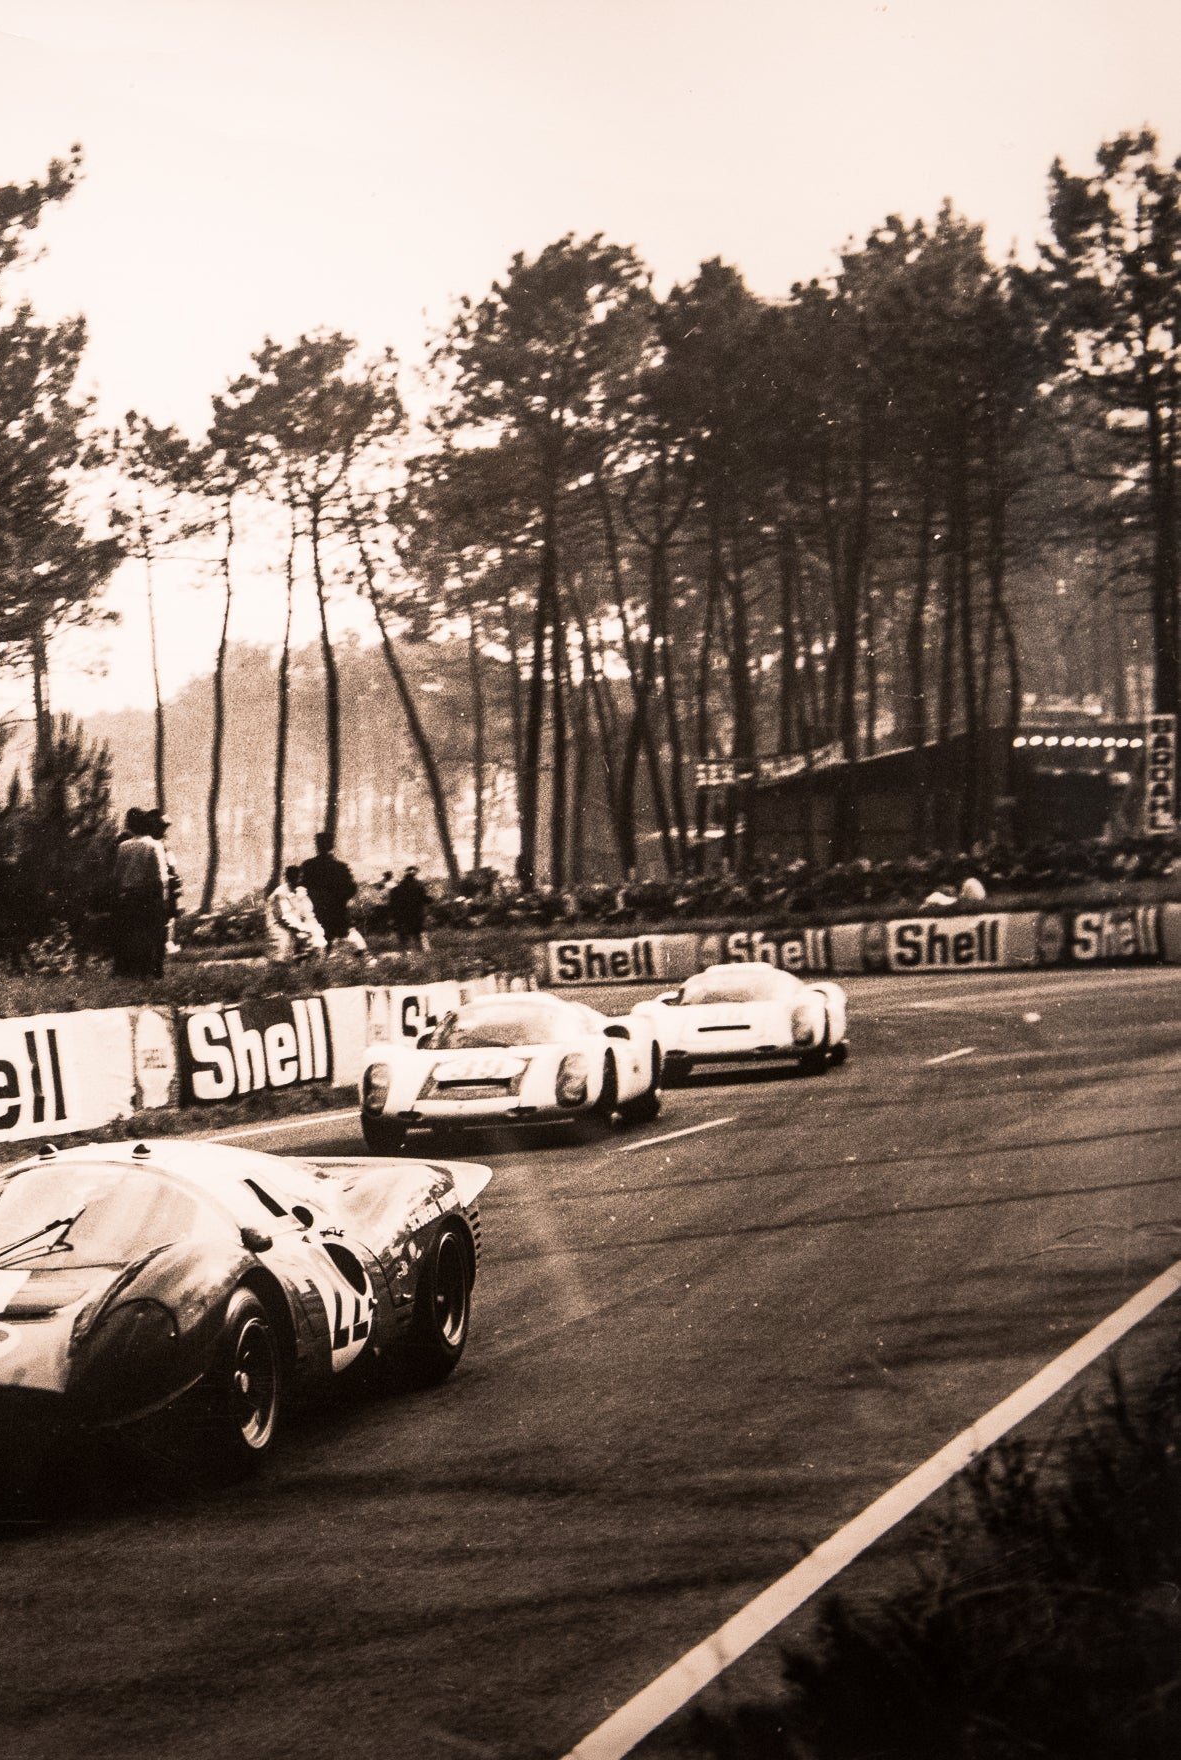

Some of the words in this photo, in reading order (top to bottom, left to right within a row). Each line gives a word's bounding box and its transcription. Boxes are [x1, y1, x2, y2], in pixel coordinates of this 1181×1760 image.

[895, 919, 999, 967] Shell
[1074, 905, 1158, 960] Shell
[557, 940, 656, 980] Shell
[187, 997, 328, 1100] Shell
